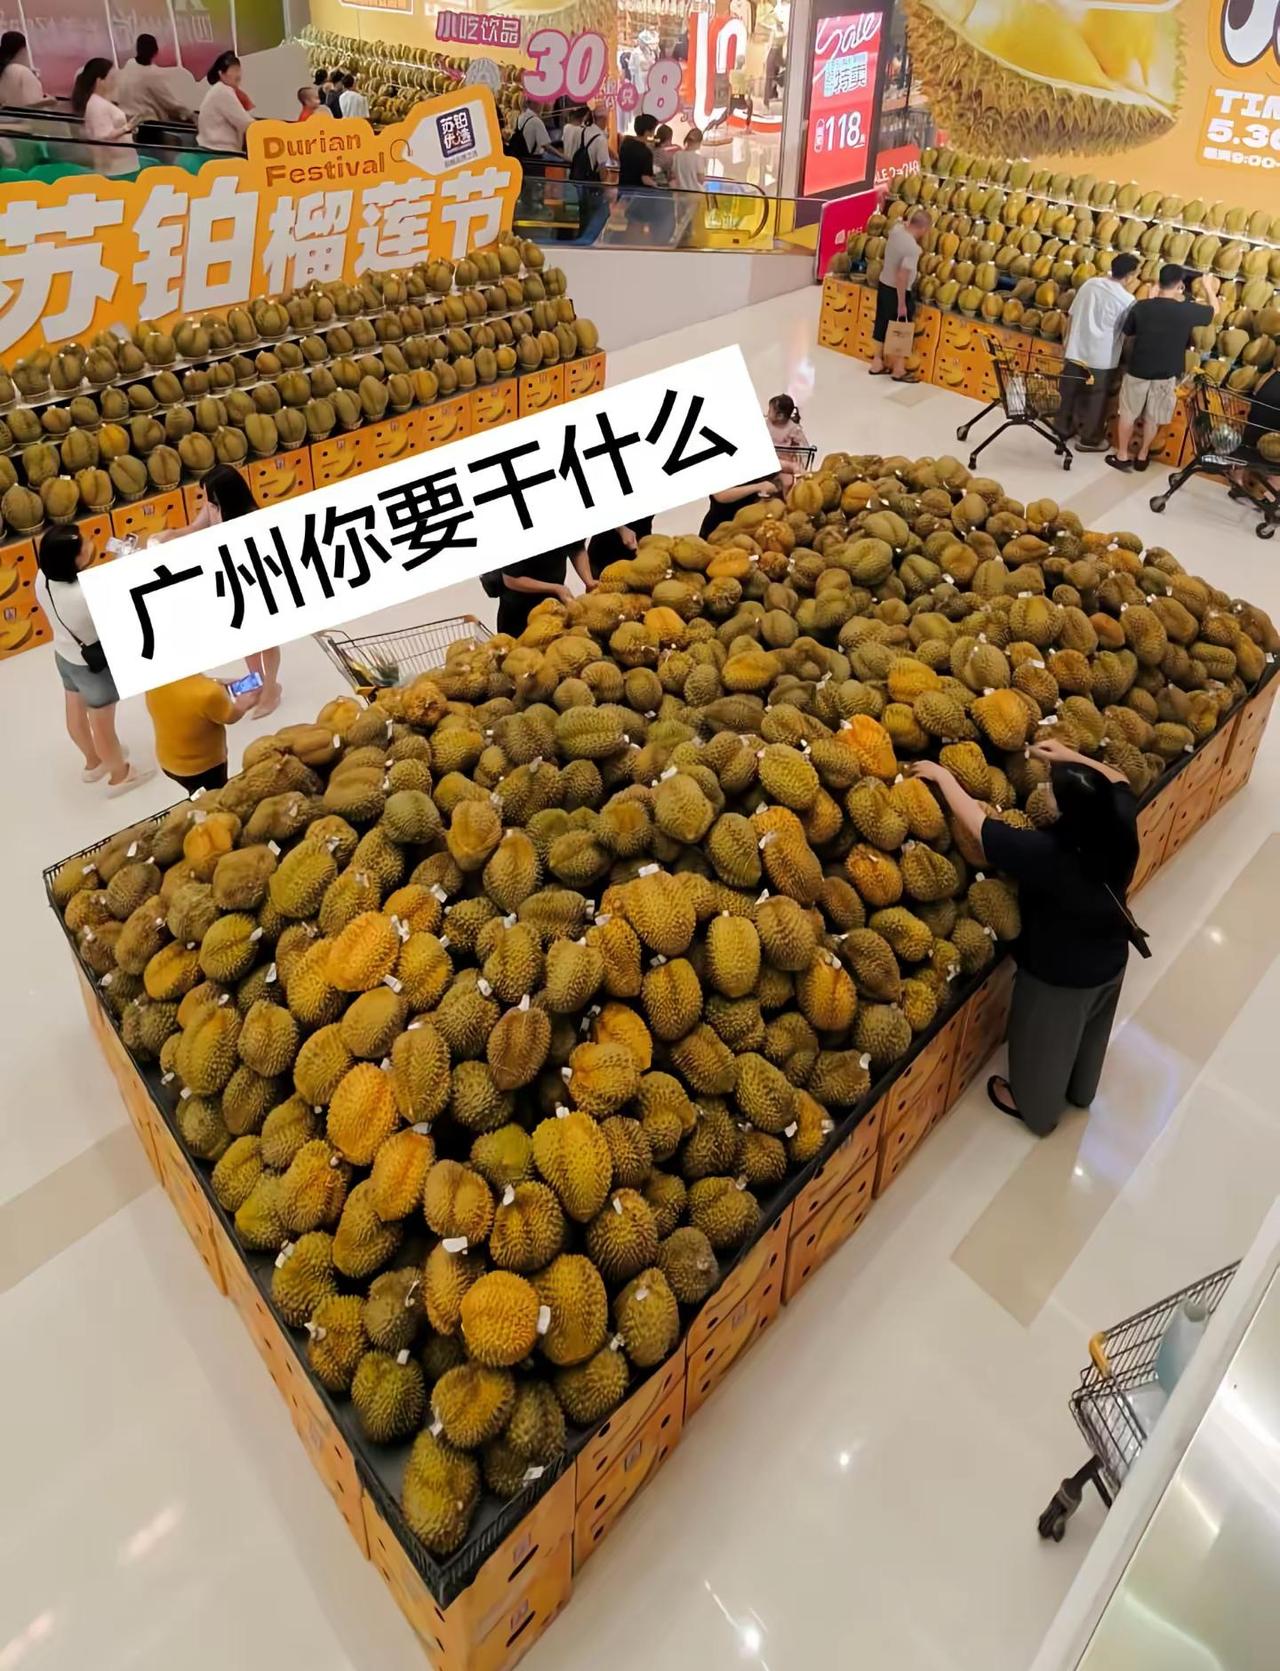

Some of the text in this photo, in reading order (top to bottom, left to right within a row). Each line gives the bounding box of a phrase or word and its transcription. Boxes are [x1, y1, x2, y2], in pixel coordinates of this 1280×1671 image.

[438, 12, 518, 44] 小吃饮品
[815, 12, 883, 66] Sale
[523, 29, 608, 101] 30
[643, 59, 682, 123] 8
[263, 130, 361, 159] Durian
[825, 111, 861, 151] 118
[266, 152, 384, 187] Festival
[0, 167, 510, 352] 苏铂榴莲节
